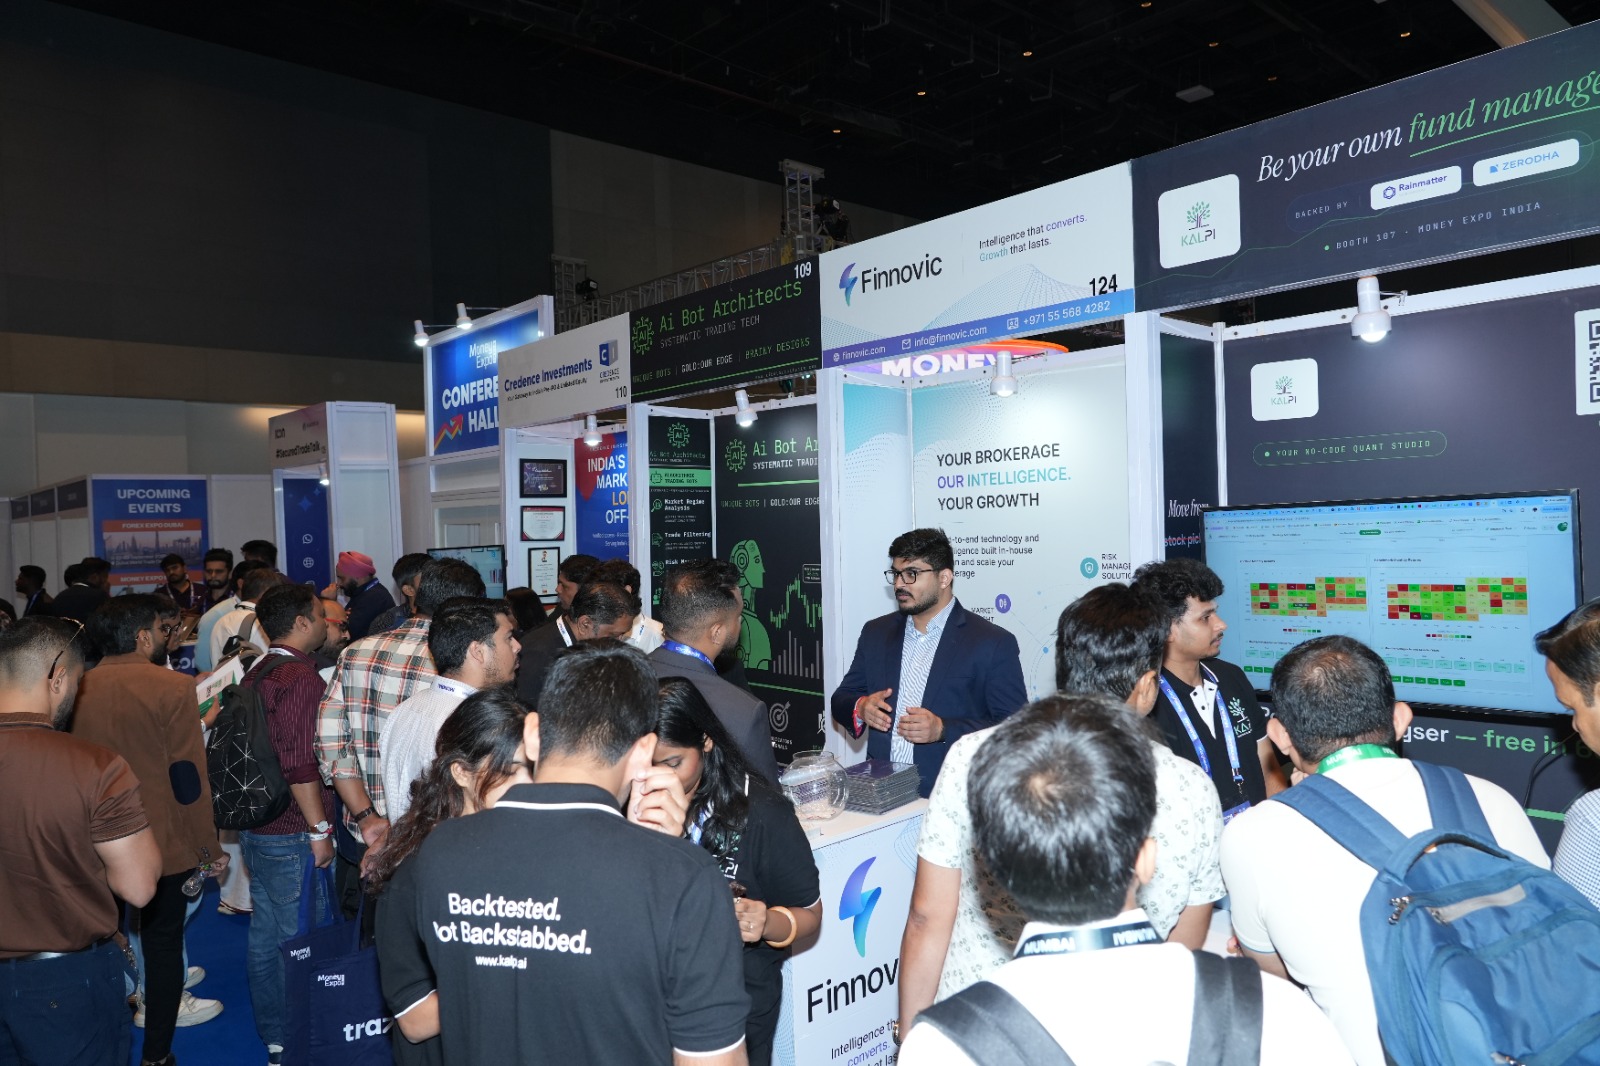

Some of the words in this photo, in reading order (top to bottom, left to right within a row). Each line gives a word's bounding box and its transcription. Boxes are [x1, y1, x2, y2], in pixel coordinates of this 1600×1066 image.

[1256, 154, 1284, 183] Be
[1284, 142, 1345, 182] your
[1348, 126, 1403, 158] own
[1408, 98, 1476, 144] fund
[1502, 150, 1560, 171] ZERODHA
[1398, 174, 1448, 192] Rainmatter
[1295, 205, 1330, 219] BACKED
[1336, 201, 1348, 210] BY
[979, 228, 1026, 250] Intelligence
[1026, 225, 1044, 238] that
[1046, 214, 1088, 232] converts.
[1336, 236, 1368, 249] BOOTH
[1376, 231, 1396, 242] 107
[1418, 218, 1454, 234] MONEY
[1462, 211, 1493, 226] EXPO
[1502, 201, 1542, 217] INDIA
[1180, 228, 1216, 248] KALPI
[980, 247, 1008, 262] Growth
[1010, 241, 1026, 255] that
[1028, 237, 1052, 250] lasts.
[794, 261, 812, 279] 109
[861, 253, 943, 294] Finnovic
[1088, 274, 1118, 297] 124
[660, 312, 674, 333] Ai
[682, 306, 705, 327] Bot
[712, 279, 802, 319] Architects
[1023, 313, 1045, 326] +971
[1048, 310, 1060, 322] 55
[1062, 306, 1082, 320] 568
[1084, 301, 1110, 315] 4282
[639, 331, 647, 340] AI
[660, 329, 702, 349] SYSTEMATIC
[704, 320, 736, 337] TRADING
[740, 314, 760, 328] TECH
[914, 324, 987, 348] info@finnovic.com
[469, 341, 493, 358] Money
[842, 346, 886, 360] finnovic.com
[476, 354, 493, 370] Expo
[632, 371, 653, 384] UNIQUE
[656, 368, 672, 380] BOTS
[681, 358, 713, 373] GOLD:OUR
[716, 354, 733, 366] EDGE
[745, 346, 772, 360] BRAINY
[776, 337, 810, 352] DESIGNS
[504, 374, 540, 392] Credence
[542, 358, 592, 382] Investments
[616, 386, 628, 398] 110
[1270, 395, 1297, 406] KALPI
[468, 406, 499, 433] HALL
[672, 451, 706, 459] Architects
[752, 440, 768, 457] Ai
[774, 437, 797, 454] Bot
[937, 452, 972, 467] YOUR
[976, 444, 1060, 464] BROKERAGE
[1276, 449, 1299, 458] YOUR
[1304, 444, 1346, 456] NO-CODE
[1352, 442, 1385, 454] QUANT
[1391, 440, 1431, 450] STUDIO
[588, 454, 626, 472] INDIA'S
[752, 459, 793, 470] SYSTEMATIC
[596, 472, 628, 489] MARK
[938, 474, 964, 489] OUR
[967, 466, 1072, 488] INTELLIGENCE.
[117, 488, 191, 499] UPCOMING
[720, 499, 742, 508] UNIQUE
[746, 498, 760, 508] BOTS
[804, 497, 820, 505] EDGE
[938, 496, 974, 510] YOUR
[976, 492, 1040, 509] GROWTH
[128, 503, 182, 514] EVENTS
[1168, 500, 1190, 518] Move
[980, 534, 1022, 544] technology
[1024, 534, 1040, 542] and
[1164, 534, 1186, 546] stock
[981, 546, 998, 554] built
[998, 546, 1033, 554] in-house
[976, 558, 996, 566] scale
[998, 560, 1014, 568] your
[1483, 730, 1536, 752] free
[1544, 735, 1567, 756] in
[1326, 748, 1363, 766] MUMAI
[448, 892, 562, 922] Backtested.
[460, 920, 592, 955] Backstabbed.
[1024, 936, 1076, 955] MUMBAI
[290, 946, 310, 957] Money
[318, 974, 342, 982] Money
[806, 957, 899, 1023] Finnov
[831, 1025, 885, 1060] Intelligence
